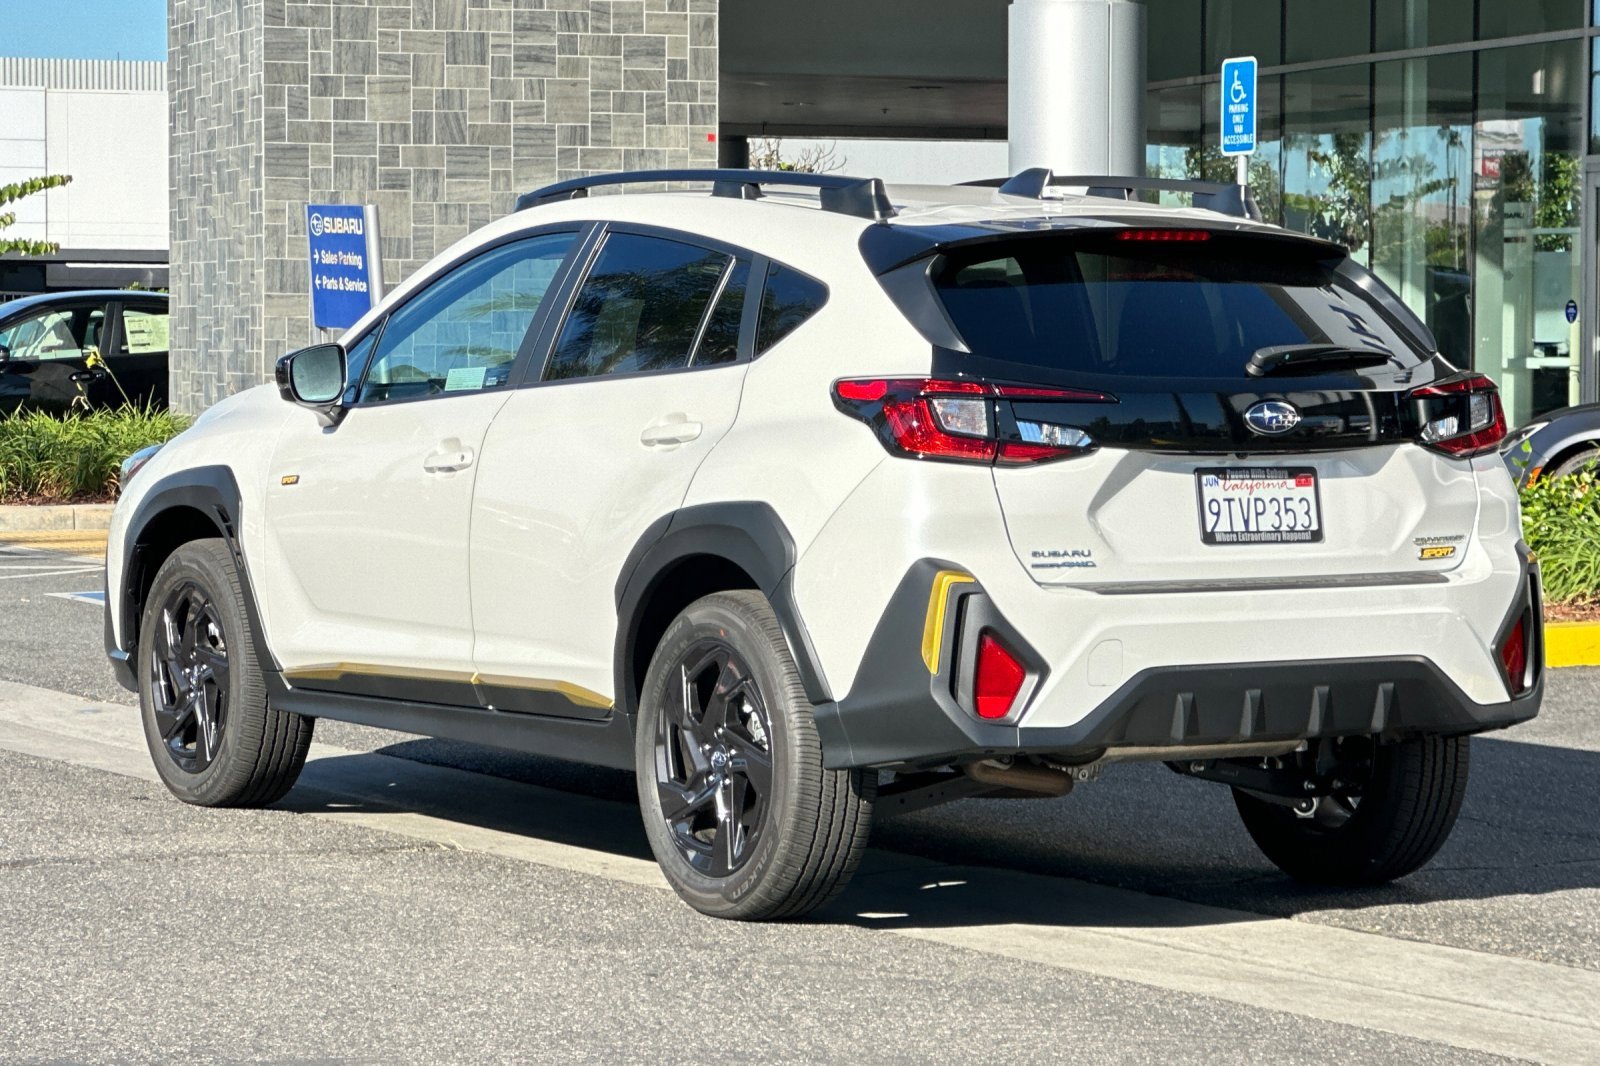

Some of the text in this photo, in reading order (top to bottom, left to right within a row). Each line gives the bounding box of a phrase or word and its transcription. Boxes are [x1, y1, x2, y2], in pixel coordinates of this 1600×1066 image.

[1229, 103, 1249, 113] PARKING
[1232, 113, 1245, 124] ONLY
[1234, 124, 1244, 134] VAN
[1224, 133, 1253, 145] ACCESSIBLE
[323, 217, 363, 235] SUBARU
[321, 249, 363, 270] Sales Parking
[322, 275, 367, 293] Parts & Service
[1205, 476, 1219, 487] JUN
[1222, 478, 1295, 496] California
[1208, 497, 1312, 532] 9TVP353
[1215, 532, 1237, 542] Where
[1238, 531, 1281, 542] Extraordinary
[1031, 549, 1092, 558] SUBARU
